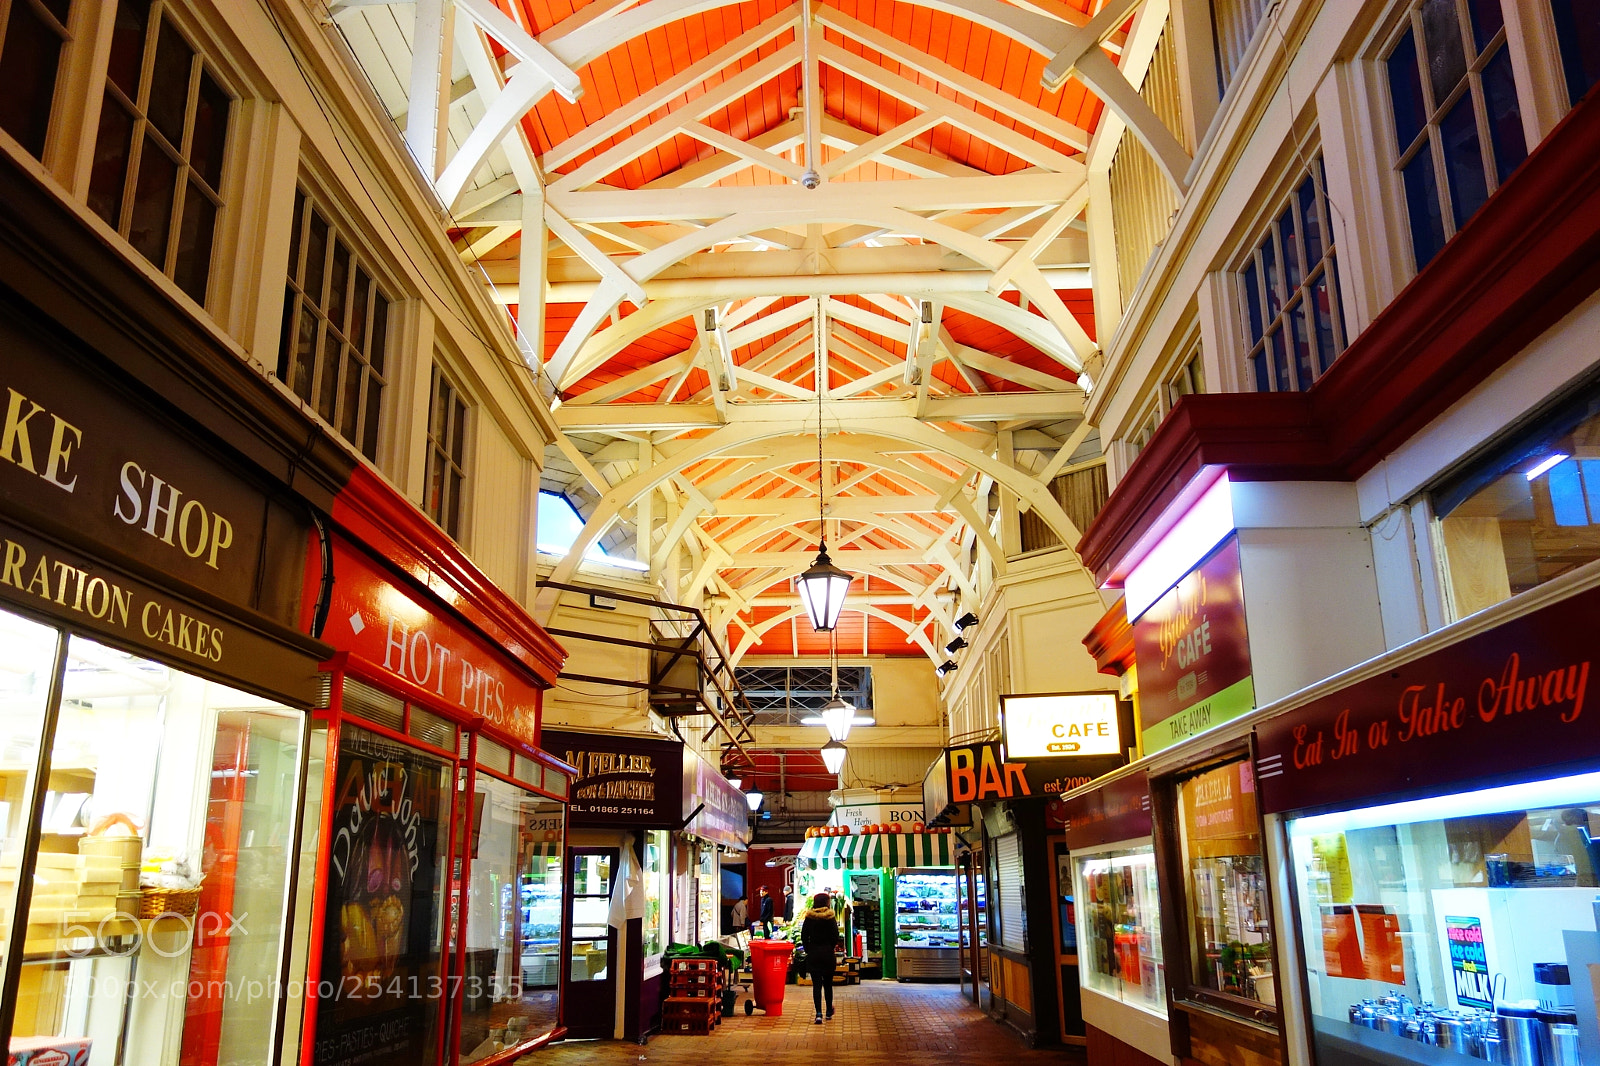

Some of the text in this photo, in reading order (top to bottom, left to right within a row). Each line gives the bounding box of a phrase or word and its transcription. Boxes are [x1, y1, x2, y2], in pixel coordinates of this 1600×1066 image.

[0, 387, 233, 570] KE SHOP
[0, 538, 223, 662] RATION CAKES
[382, 615, 505, 725] HOT PIES
[1170, 703, 1212, 740] TAKE AWAY
[1293, 652, 1590, 770] Eat In or Take Away
[587, 750, 657, 779] FELLER,
[950, 745, 1031, 803] BAR
[577, 783, 599, 800] SON
[599, 782, 607, 799] &
[1044, 778, 1064, 793] est
[332, 758, 390, 886] David
[568, 804, 654, 816] EL. 01865 251164
[845, 808, 863, 817] Fresh
[854, 817, 872, 826] Herbs
[889, 810, 925, 822] BON
[1465, 926, 1482, 943] cold
[1449, 939, 1485, 963] ice cold
[1455, 969, 1493, 1002] MILK
